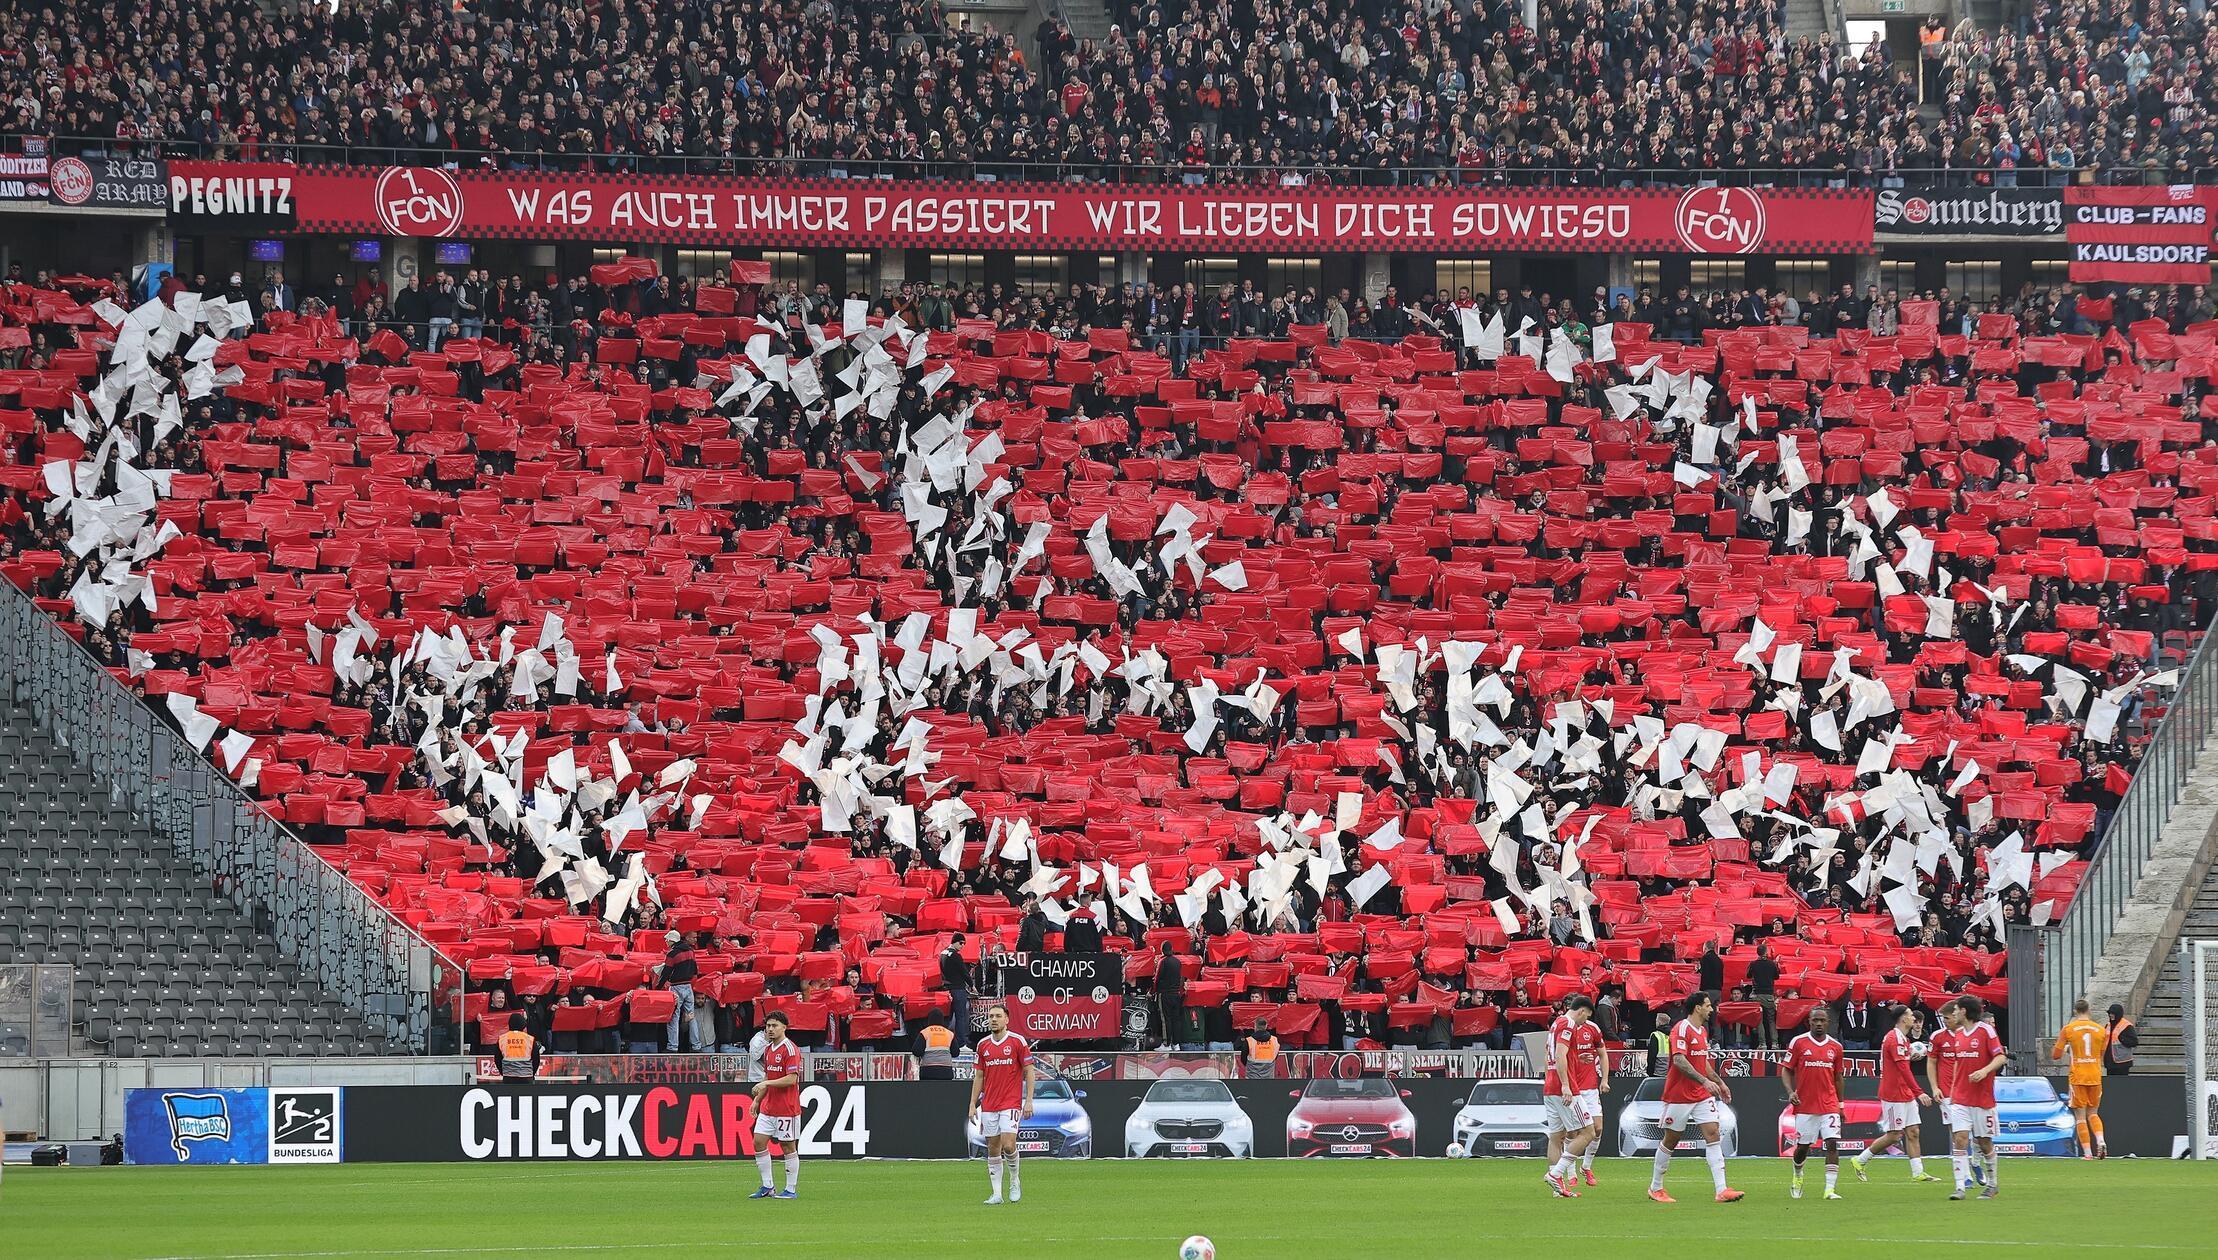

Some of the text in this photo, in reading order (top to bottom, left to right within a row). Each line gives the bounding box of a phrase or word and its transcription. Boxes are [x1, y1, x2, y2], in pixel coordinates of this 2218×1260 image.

[105, 157, 157, 179] RED
[59, 175, 85, 192] FCN
[95, 181, 168, 205] ARMY
[401, 169, 424, 195] 1.
[171, 176, 291, 215] PEGNITZ
[1717, 188, 1732, 215] 1.
[388, 193, 453, 227] FCN
[507, 188, 1631, 239] WAS AUCH IMMER PASSIERT WIR LIEBEN DICH SOWIESO
[1687, 209, 1752, 245] FCN
[2077, 244, 2208, 264] KAULSDORF
[396, 254, 416, 279] G
[1030, 959, 1096, 978] CHAMPS
[1053, 987, 1074, 1005] OF
[1026, 1013, 1100, 1031] GERMANY
[2082, 1033, 2091, 1056] 1
[847, 1057, 903, 1079] SETION
[1364, 1052, 1382, 1068] DIE
[1805, 1060, 1833, 1068] toolcraft
[460, 1085, 870, 1158] CHECKCAR24
[778, 1119, 791, 1132] 27
[1010, 1110, 1020, 1122] 10
[1986, 1116, 1993, 1128] 5
[314, 1118, 330, 1140] 2
[274, 1149, 333, 1157] BUNDESLIGA
[1332, 1145, 1371, 1153] CHECKCARS24
